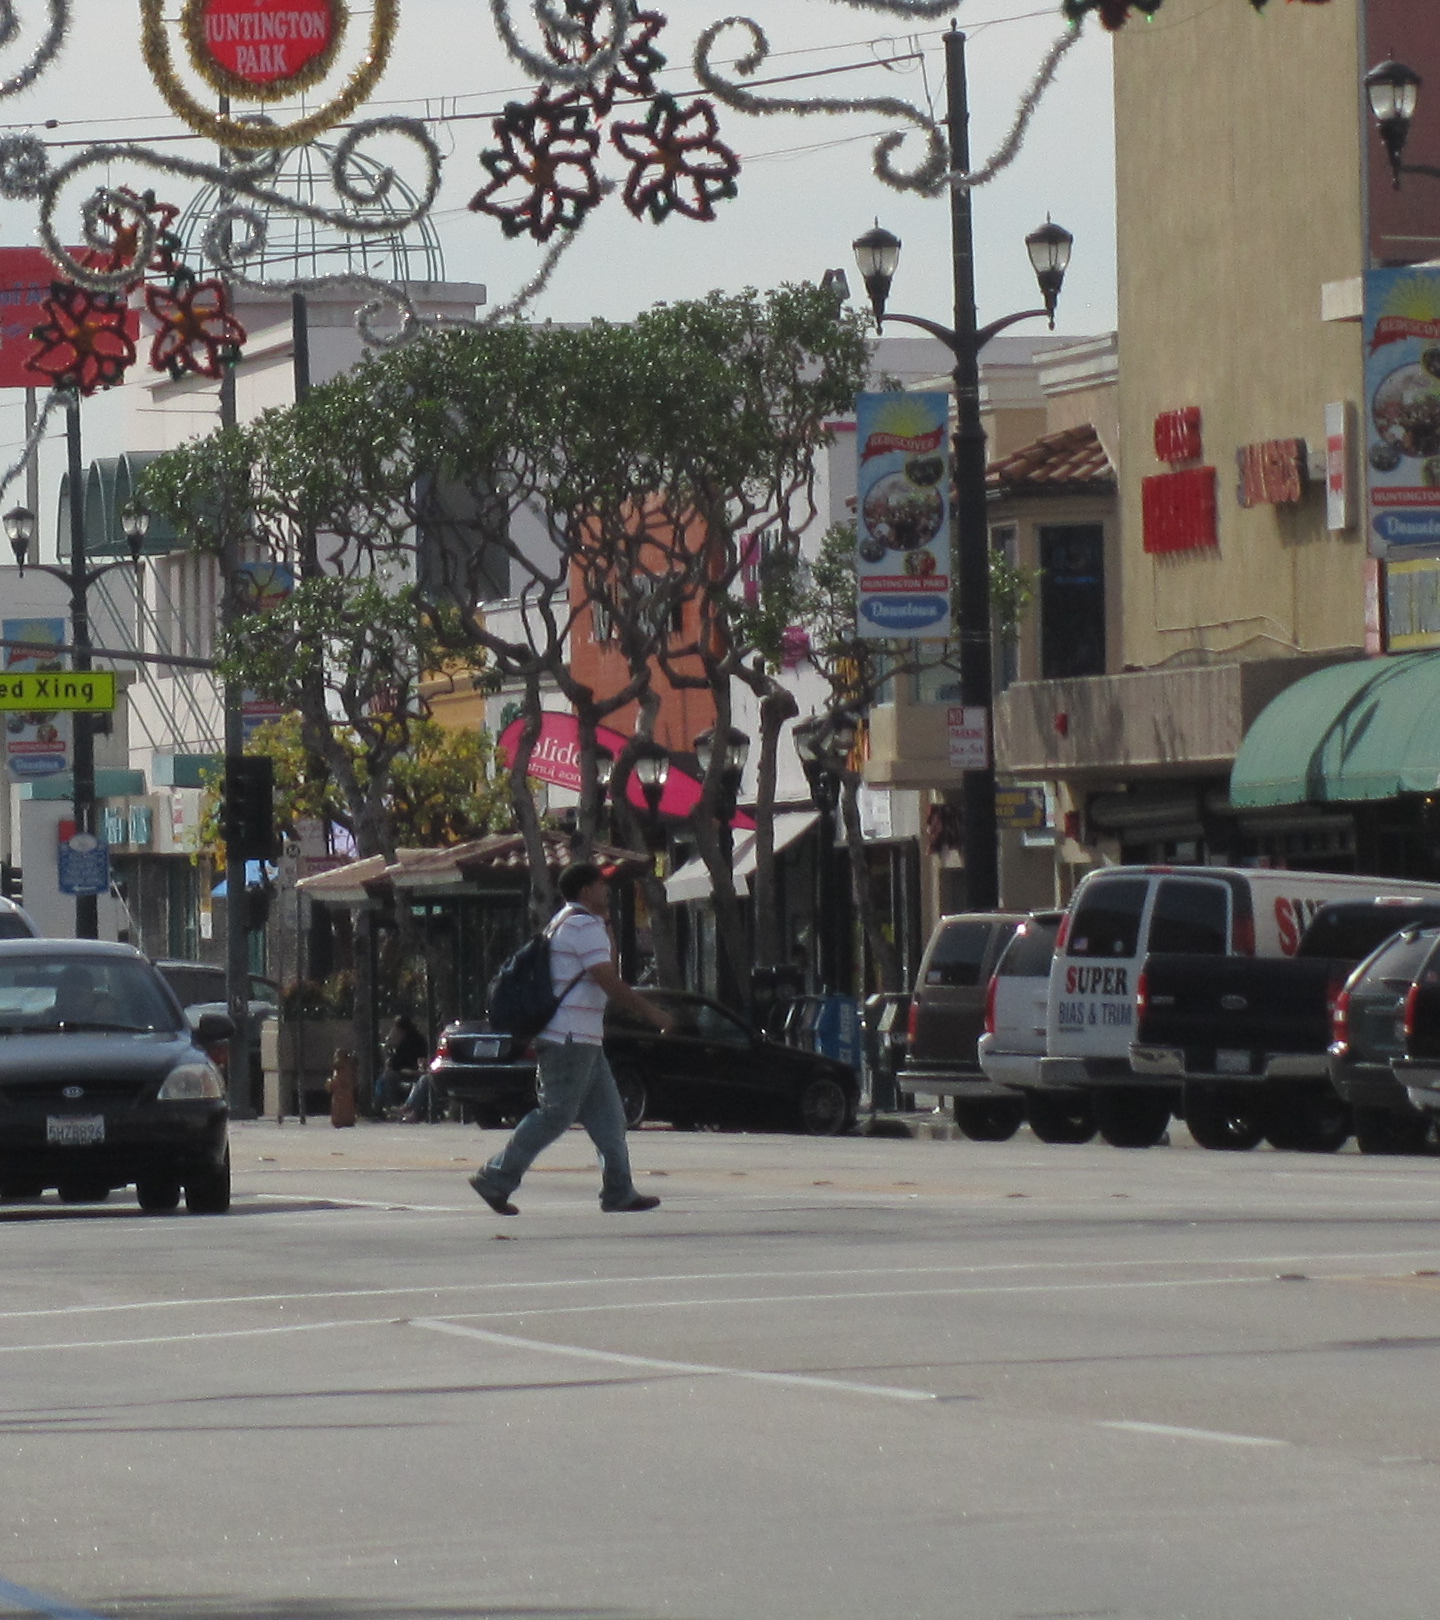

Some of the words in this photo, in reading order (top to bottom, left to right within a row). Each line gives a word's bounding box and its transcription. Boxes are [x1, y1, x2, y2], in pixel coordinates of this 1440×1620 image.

[235, 44, 287, 74] PARK
[35, 678, 95, 703] Xing
[1066, 965, 1128, 996] SUPER
[1088, 1002, 1097, 1025] &
[1102, 1002, 1132, 1026] TRIM
